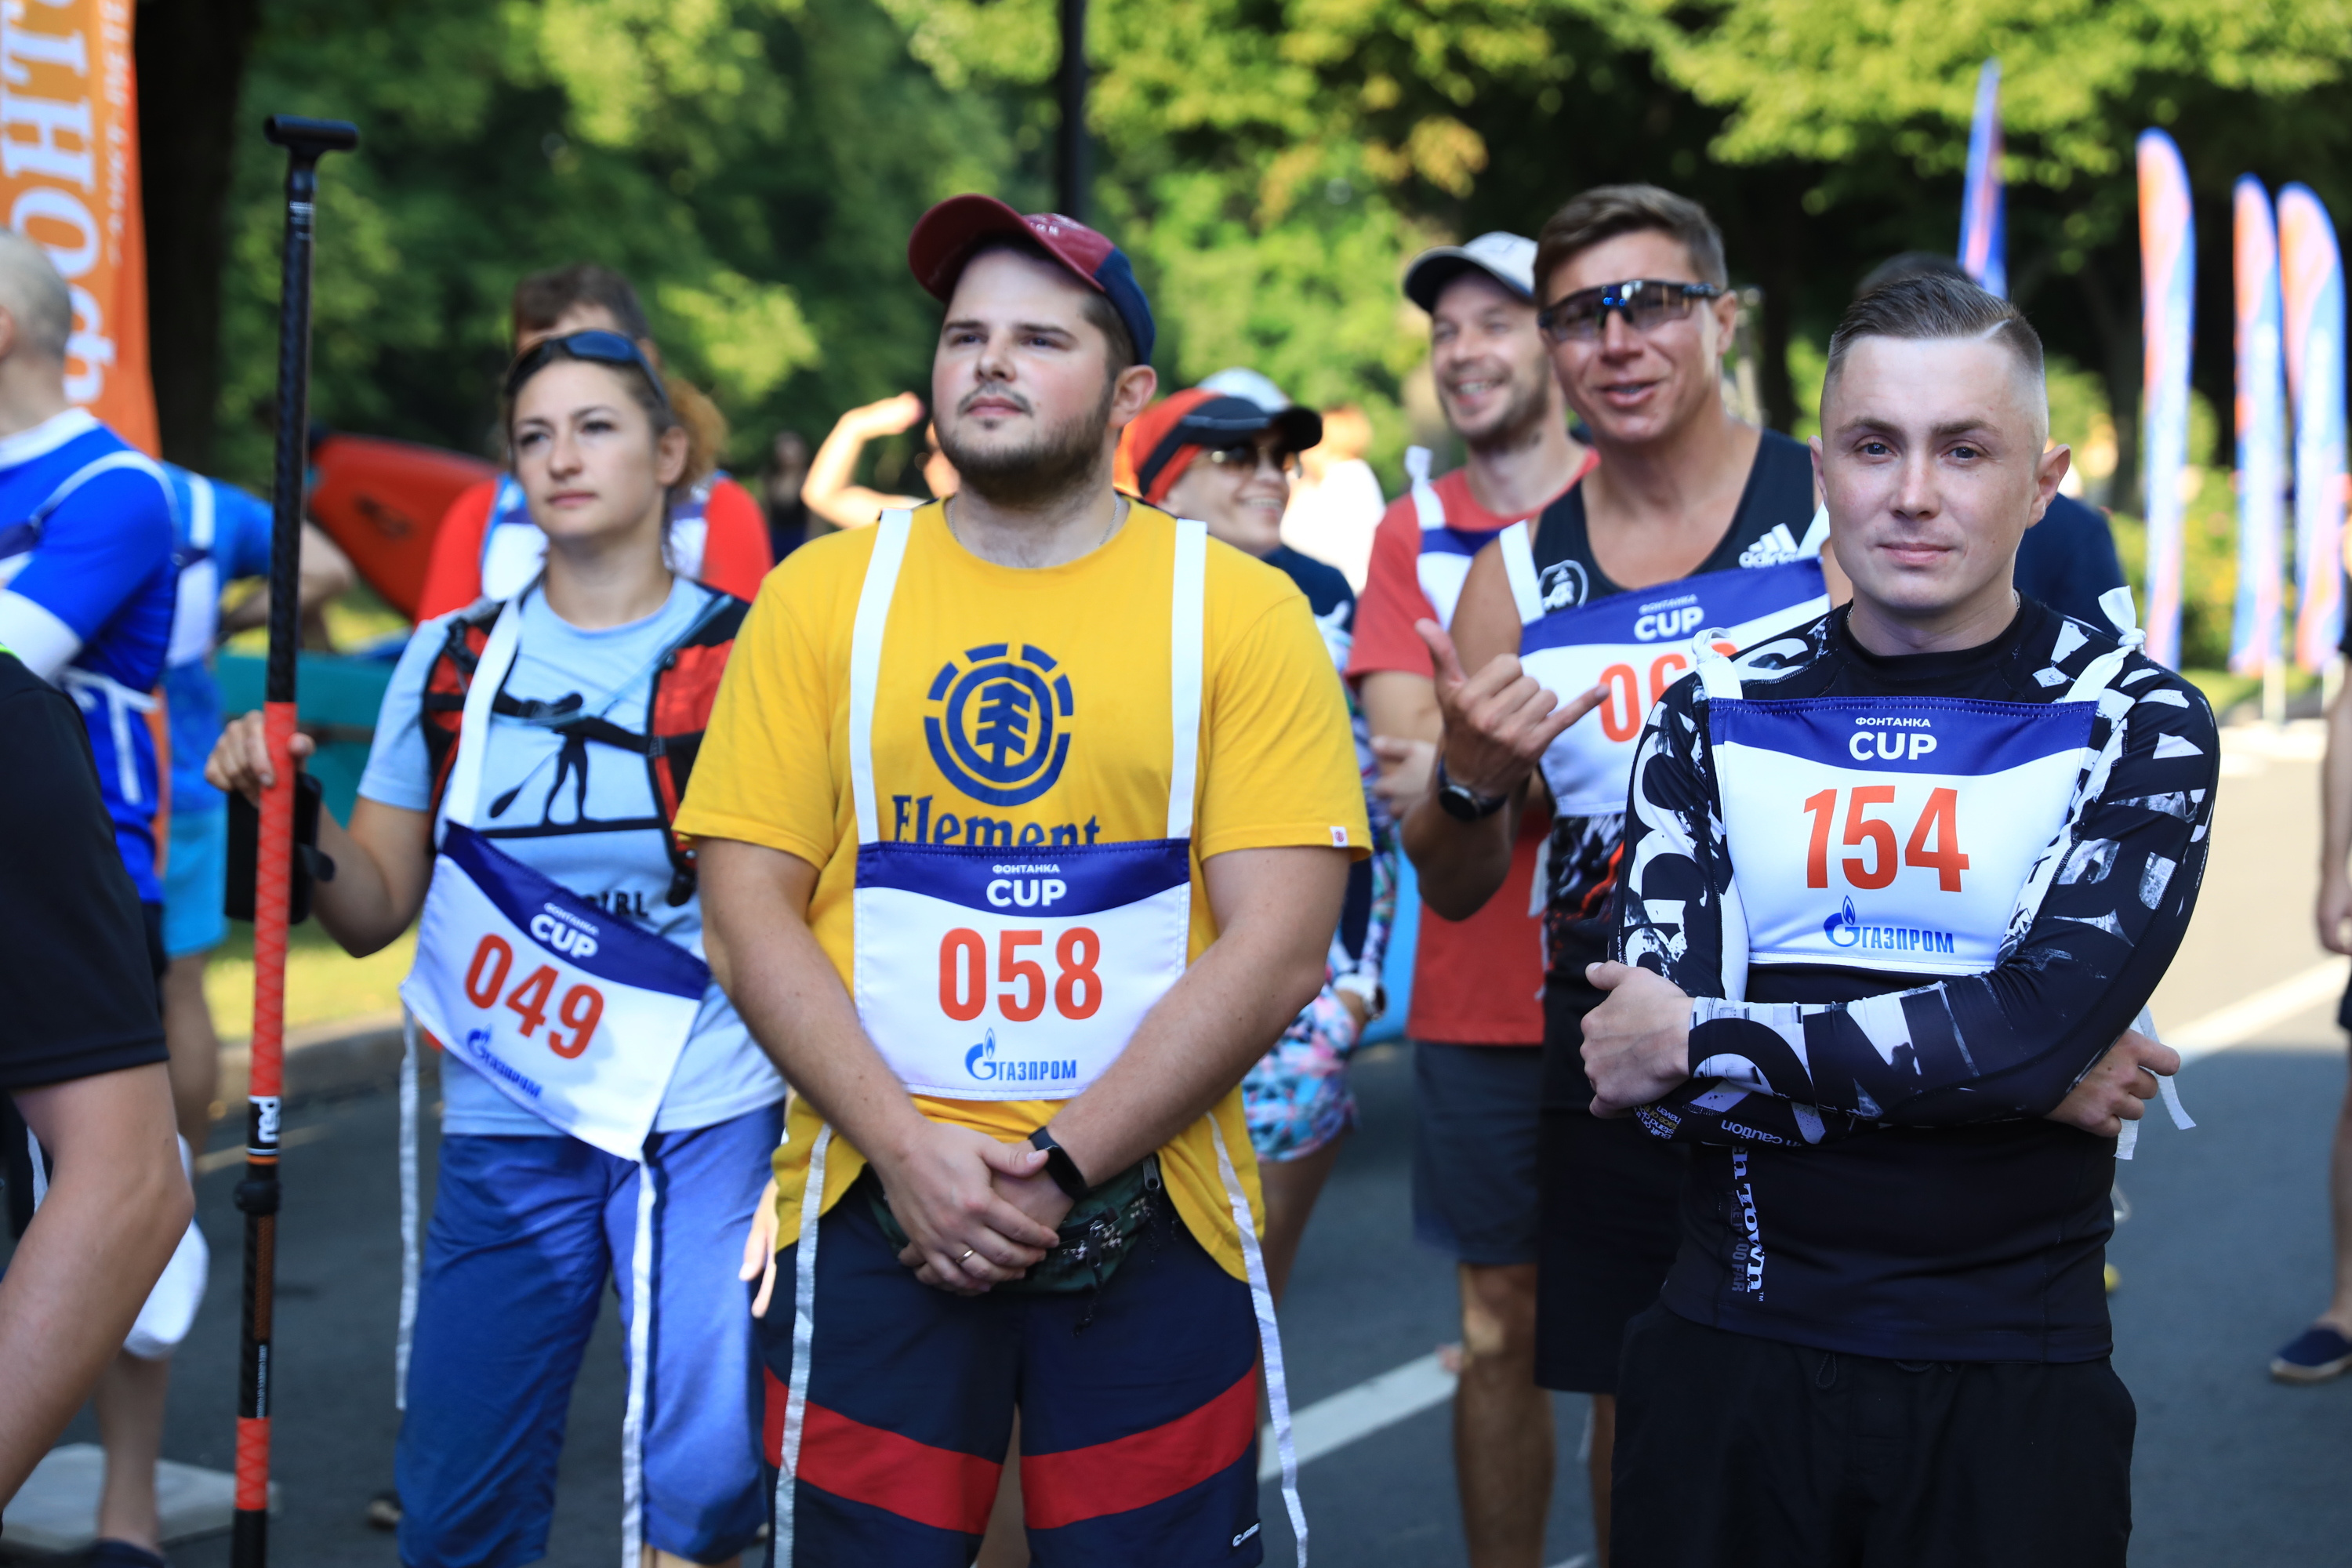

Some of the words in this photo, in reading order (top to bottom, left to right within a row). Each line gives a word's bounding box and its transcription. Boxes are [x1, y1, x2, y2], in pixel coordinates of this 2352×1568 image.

[1639, 593, 1697, 614] ФОНТАНКА
[1634, 605, 1704, 642] CUP
[1599, 642, 1739, 743] 06
[1855, 717, 1931, 728] ФОНТАНКА
[1849, 731, 1937, 761] CUP
[891, 794, 1100, 847] Element
[1803, 785, 1970, 892] 154
[992, 864, 1060, 875] ФОНТАНКА
[985, 878, 1067, 907] CUP
[544, 902, 599, 936] ФОНТАНКА
[530, 913, 599, 958] CUP
[1861, 927, 1955, 953] ГАЗПРОМ
[938, 926, 1102, 1022] 058
[464, 932, 604, 1059] 049
[998, 1059, 1077, 1081] ГАЗПРОМ
[1650, 1118, 1675, 1134] stand
[1657, 1105, 1682, 1125] haven
[1659, 1117, 1678, 1130] face
[1721, 1120, 1784, 1145] caution
[1736, 1183, 1765, 1293] Town
[1731, 1263, 1745, 1293] FAR
